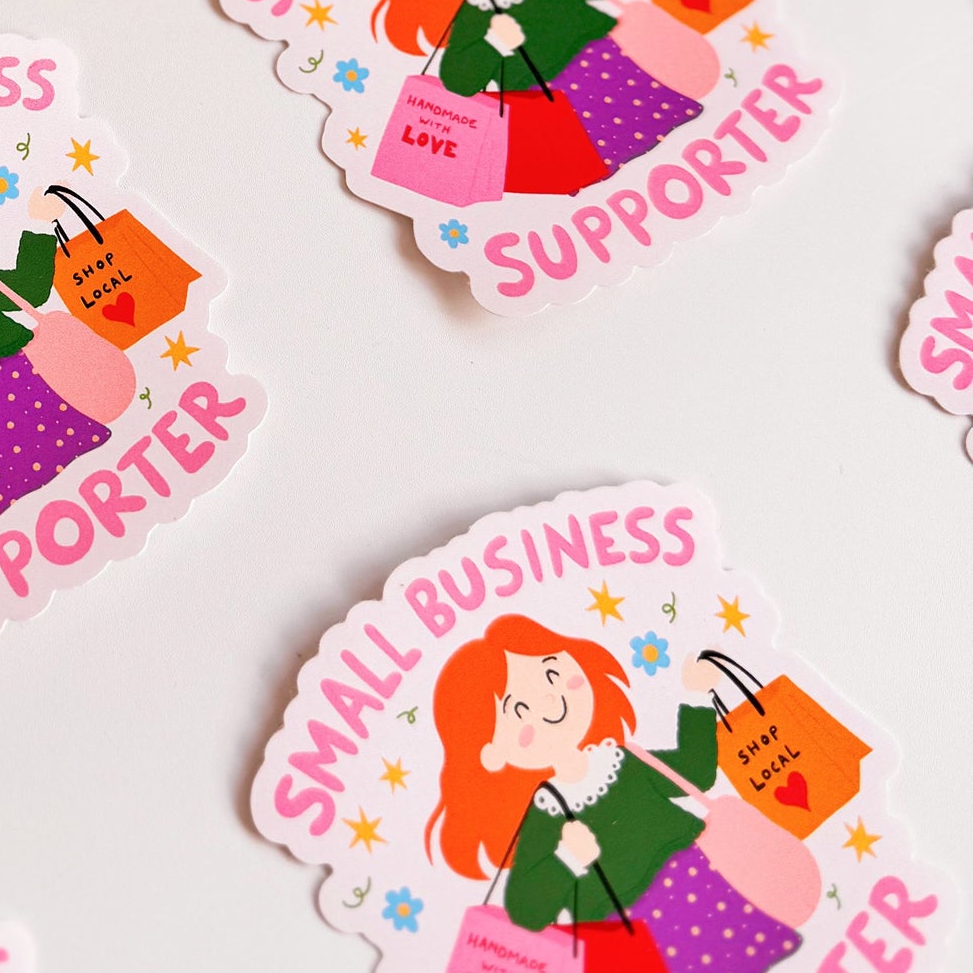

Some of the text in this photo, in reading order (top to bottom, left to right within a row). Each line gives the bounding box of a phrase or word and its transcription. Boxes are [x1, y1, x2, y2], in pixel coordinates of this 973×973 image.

[407, 95, 478, 129] HANDMADE
[419, 116, 451, 134] WITH
[401, 124, 458, 158] LOVE
[483, 63, 824, 299] SUPPORTER
[72, 252, 114, 286] SHOP
[80, 269, 133, 309] LOCAL
[273, 506, 696, 837] SMALL BUSINESS
[738, 725, 778, 765] SHOP
[749, 744, 801, 792] LOCAL
